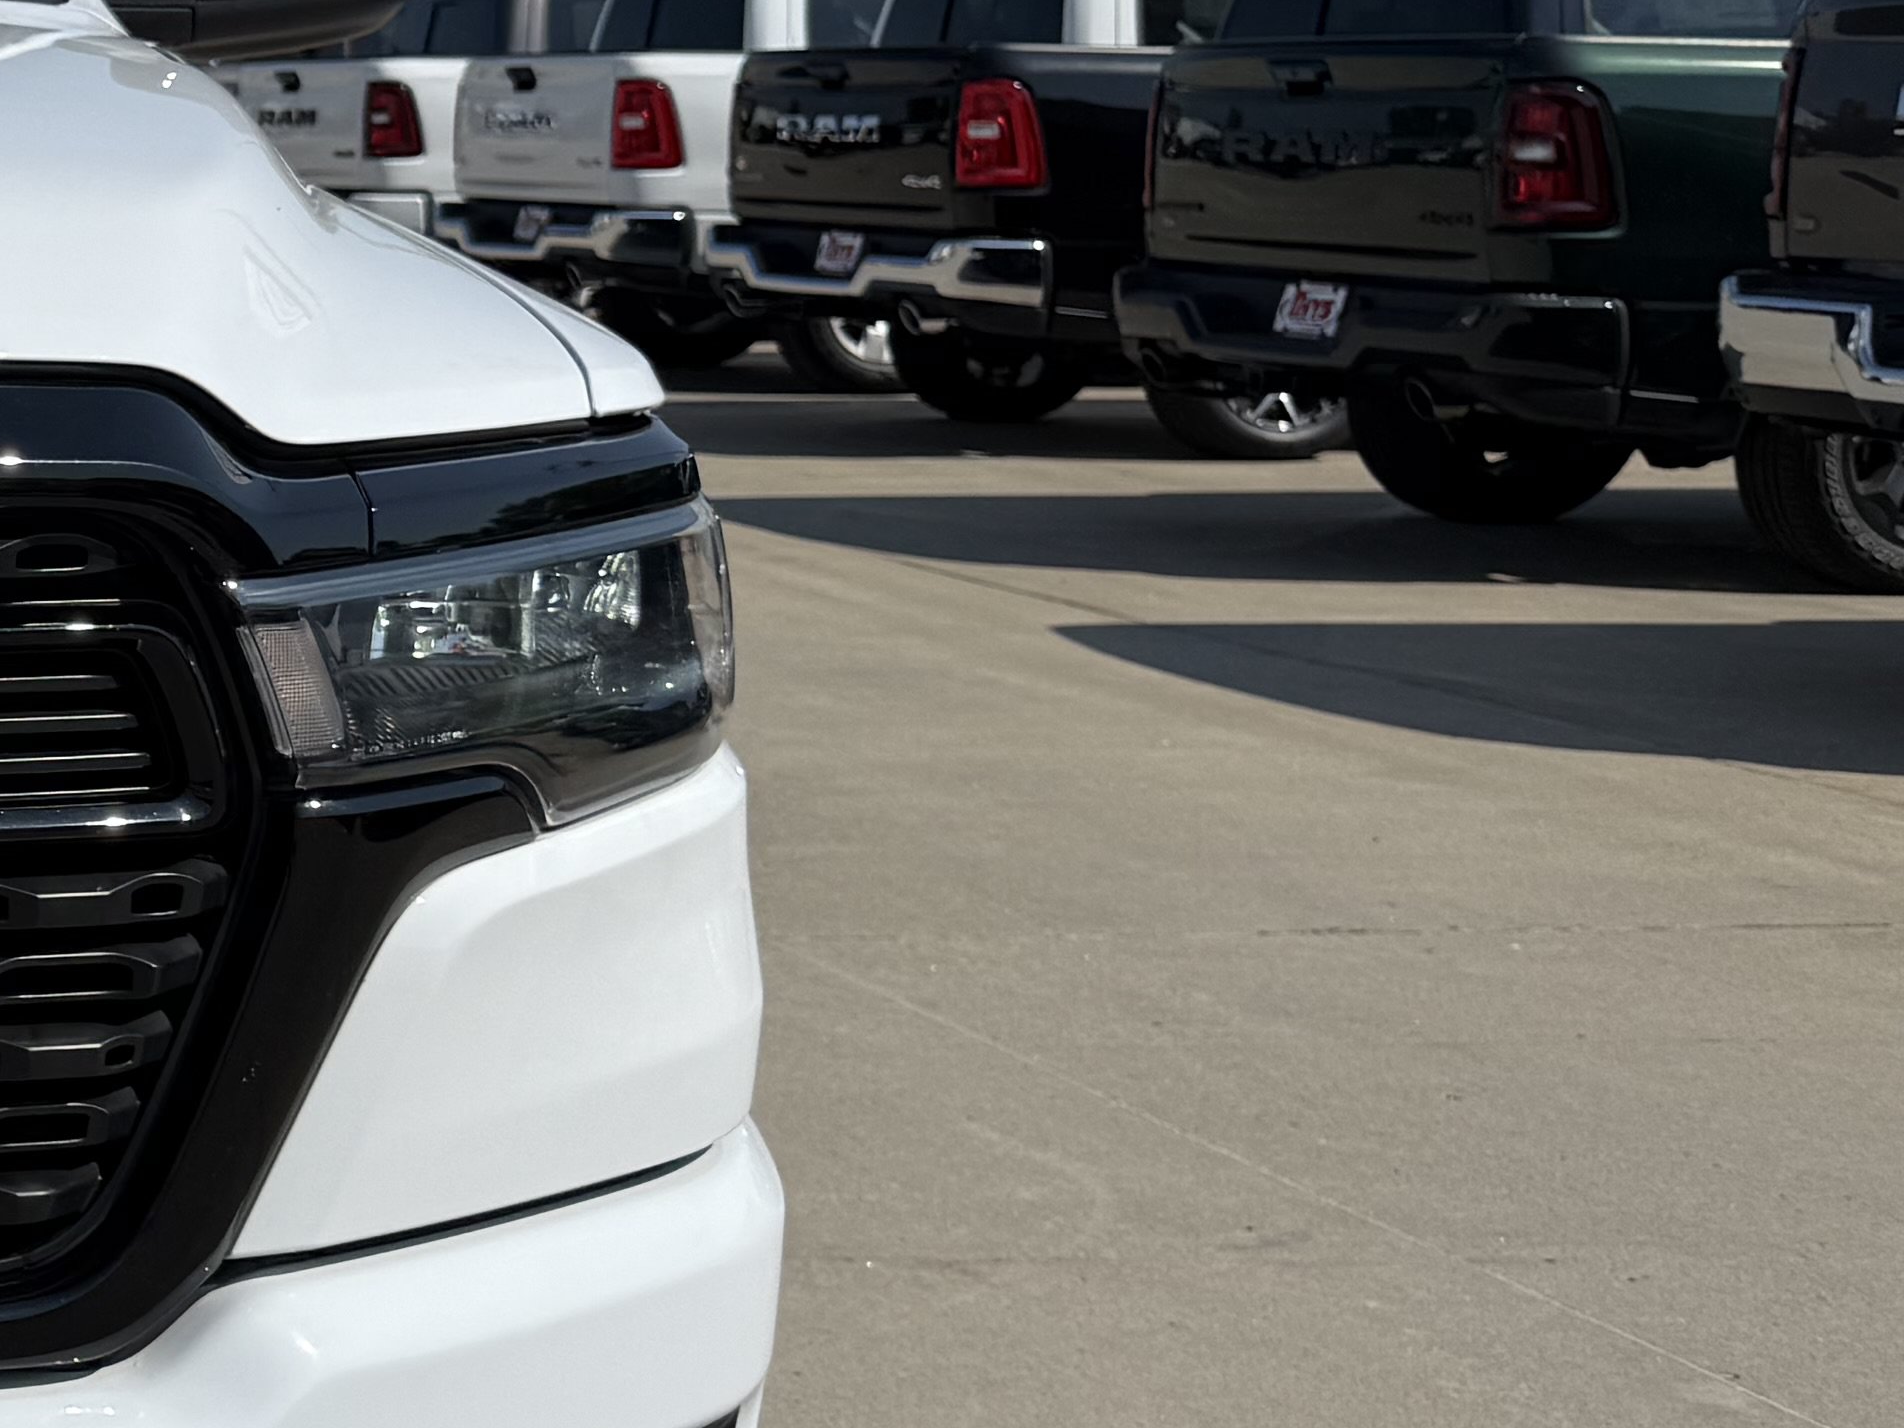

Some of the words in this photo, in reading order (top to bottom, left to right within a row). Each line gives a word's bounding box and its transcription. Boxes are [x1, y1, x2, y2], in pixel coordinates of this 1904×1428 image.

[258, 110, 315, 125] RAM
[776, 114, 880, 143] RAM
[1223, 126, 1388, 166] RAM
